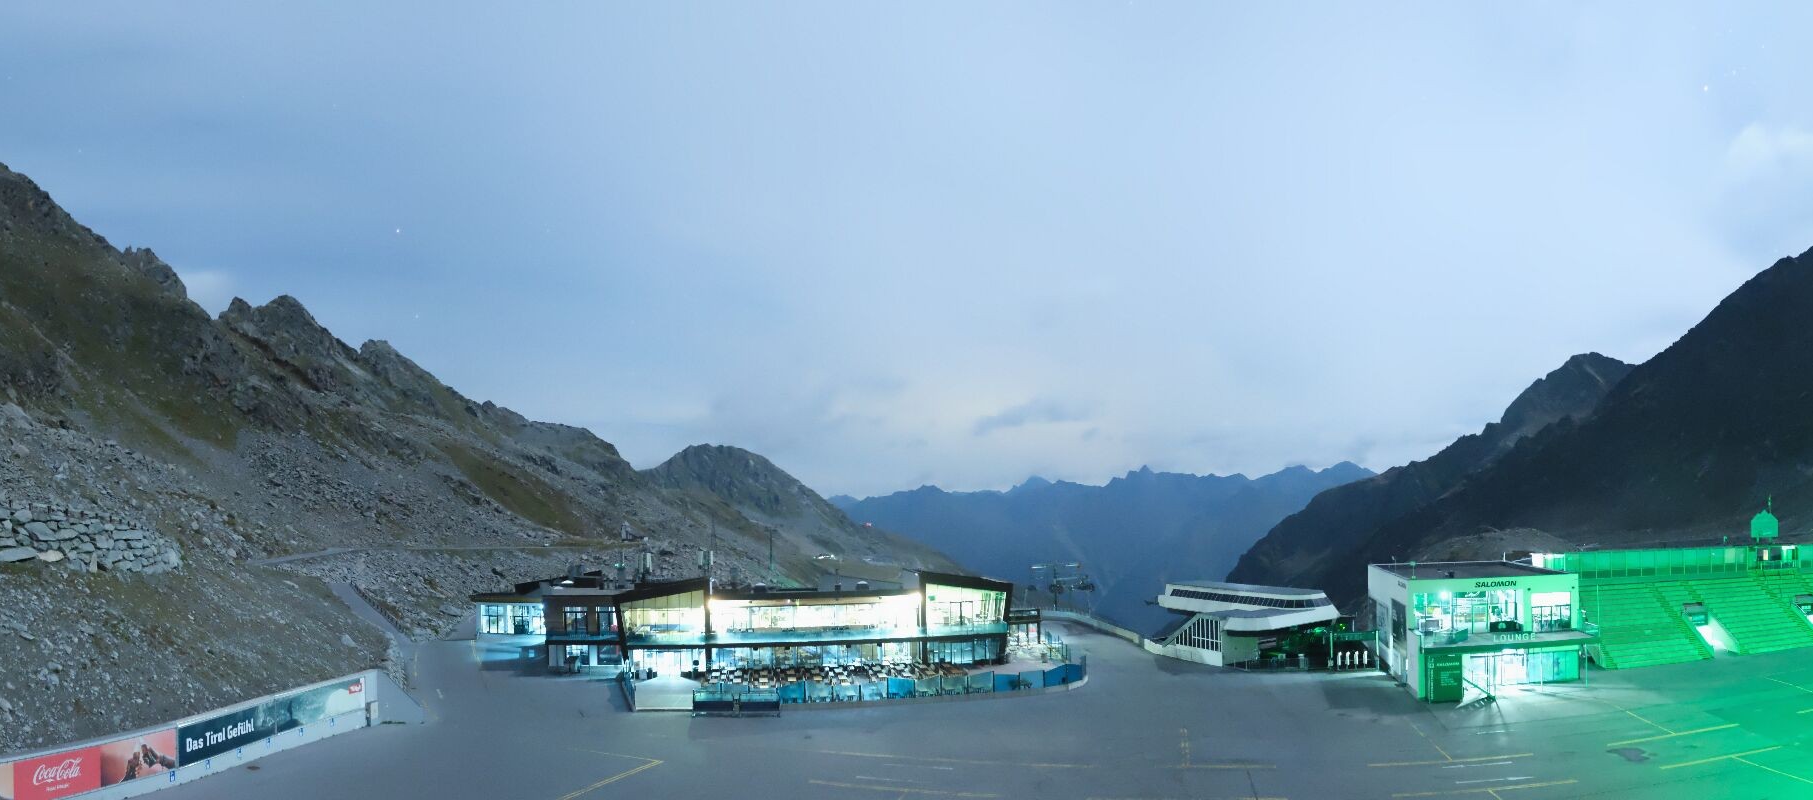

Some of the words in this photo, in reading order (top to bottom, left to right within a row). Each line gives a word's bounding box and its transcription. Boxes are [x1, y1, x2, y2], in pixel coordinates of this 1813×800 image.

[1474, 580, 1517, 588] SALOMON
[1493, 632, 1536, 642] LOUNGE
[186, 737, 204, 753] Das
[205, 727, 226, 747] Tirol
[227, 717, 255, 740] Gefühl
